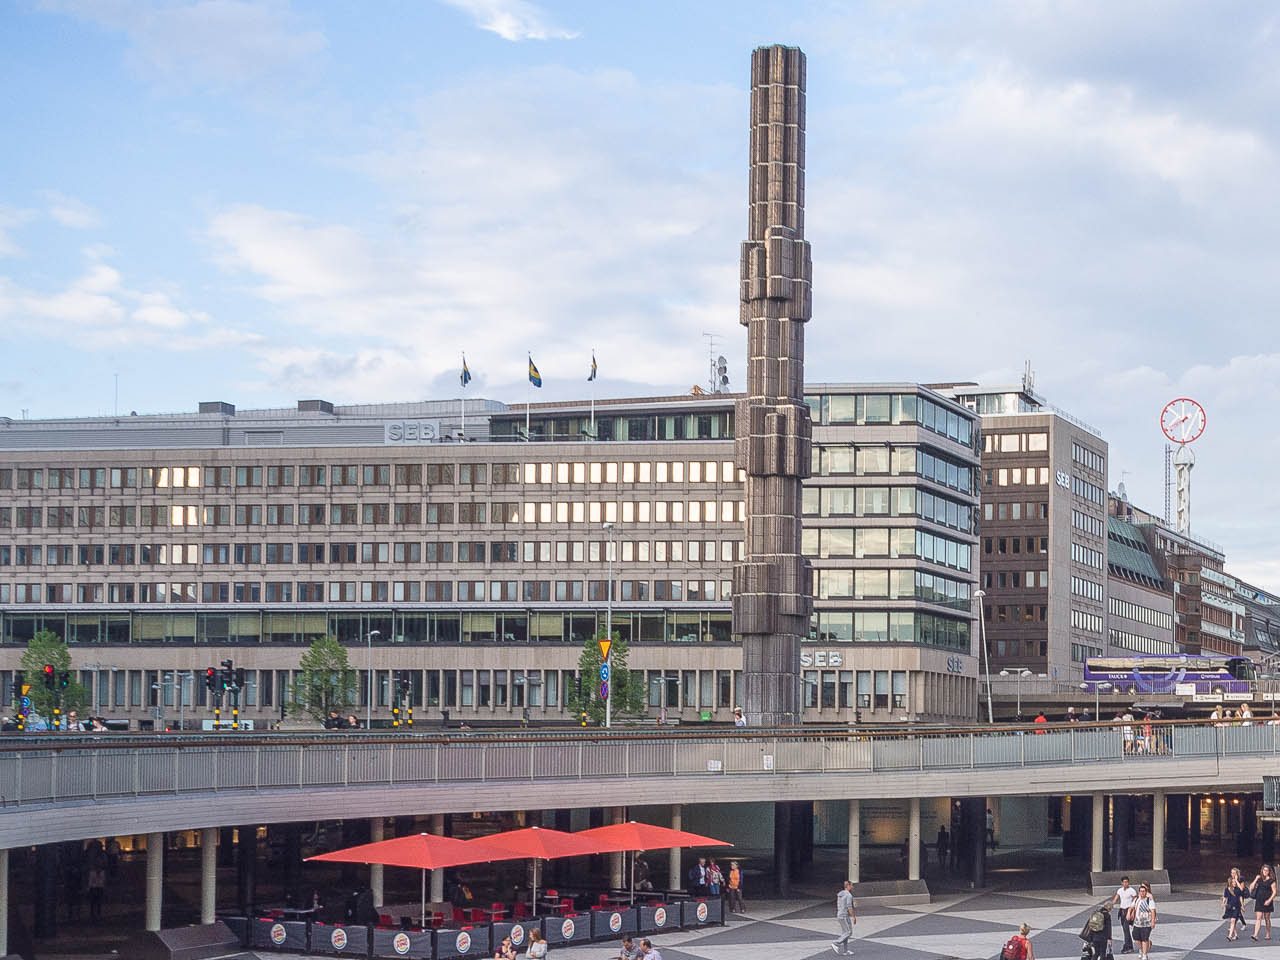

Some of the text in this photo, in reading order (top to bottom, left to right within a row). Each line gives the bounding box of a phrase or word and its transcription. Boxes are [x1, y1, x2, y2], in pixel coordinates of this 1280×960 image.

[389, 424, 435, 441] SEB
[1056, 470, 1070, 489] SEB
[800, 651, 842, 667] SEB
[947, 656, 964, 673] SEB
